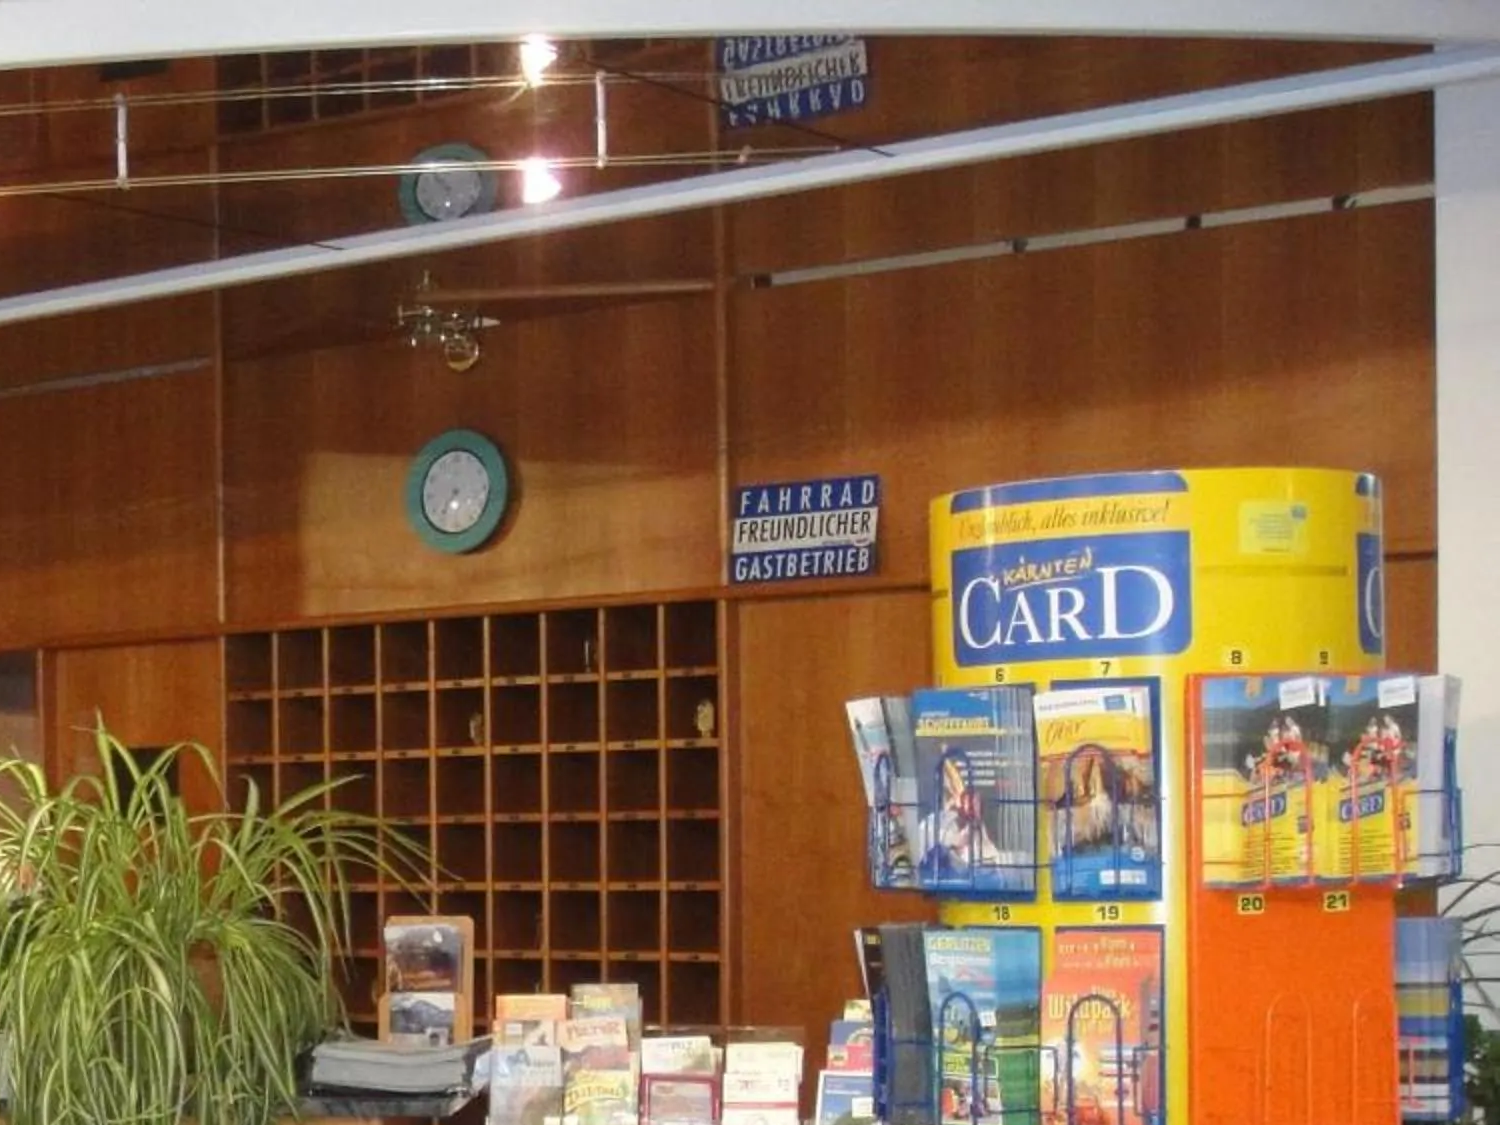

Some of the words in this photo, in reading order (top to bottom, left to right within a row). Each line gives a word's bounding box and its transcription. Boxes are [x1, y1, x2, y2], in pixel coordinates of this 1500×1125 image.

[740, 479, 876, 515] FAHRRAD
[738, 511, 872, 544] FREUNDLICHER
[735, 547, 870, 582] GASTBETRIEB
[958, 564, 1175, 650] CARD
[1231, 649, 1243, 665] 8
[1100, 660, 1112, 676] 7
[1240, 897, 1263, 912] 20
[1326, 894, 1348, 908] 21
[993, 907, 1011, 921] 18
[1097, 905, 1120, 921] 19
